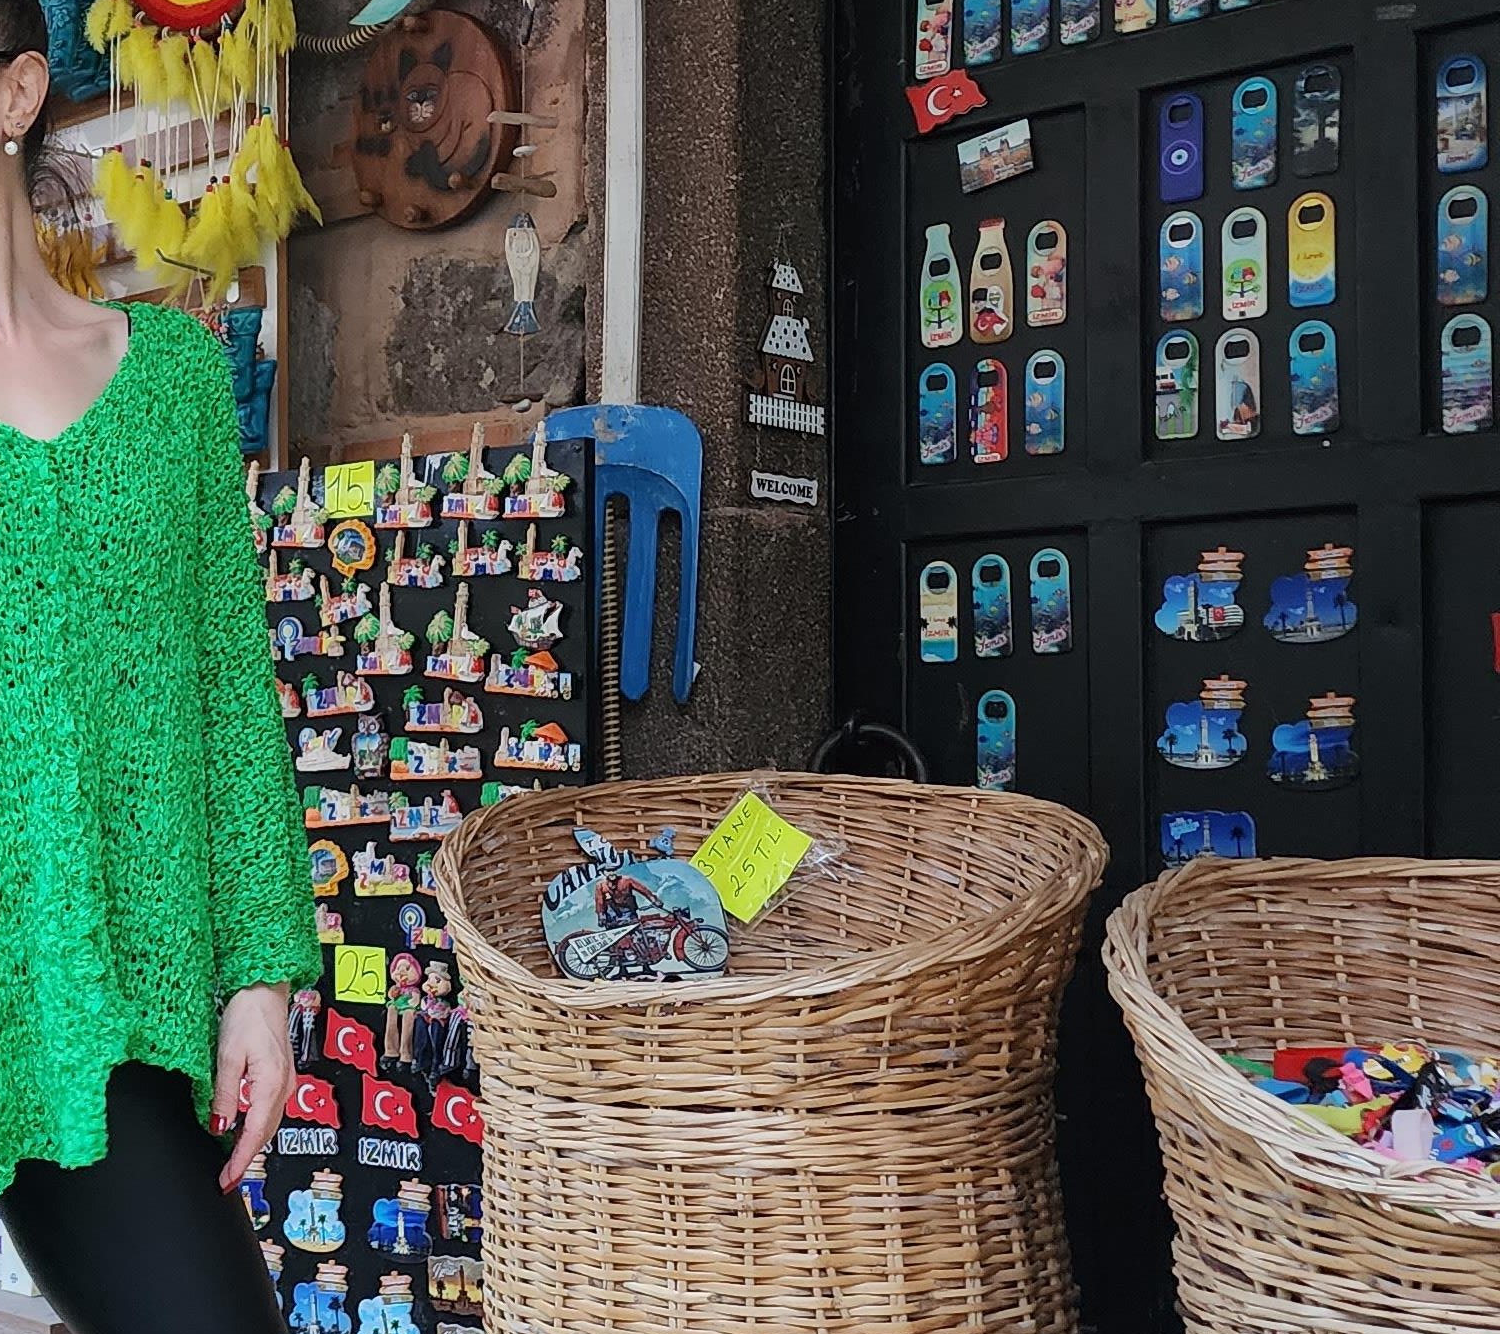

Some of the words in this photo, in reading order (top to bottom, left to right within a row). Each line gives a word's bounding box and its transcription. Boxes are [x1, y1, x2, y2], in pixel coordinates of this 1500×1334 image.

[327, 465, 364, 514] 15
[755, 475, 814, 501] WELCOME
[707, 801, 752, 859] TANE
[729, 860, 756, 898] 25
[337, 949, 380, 998] 25
[276, 1127, 340, 1156] IZMIR
[357, 1136, 423, 1173] IZMIR
